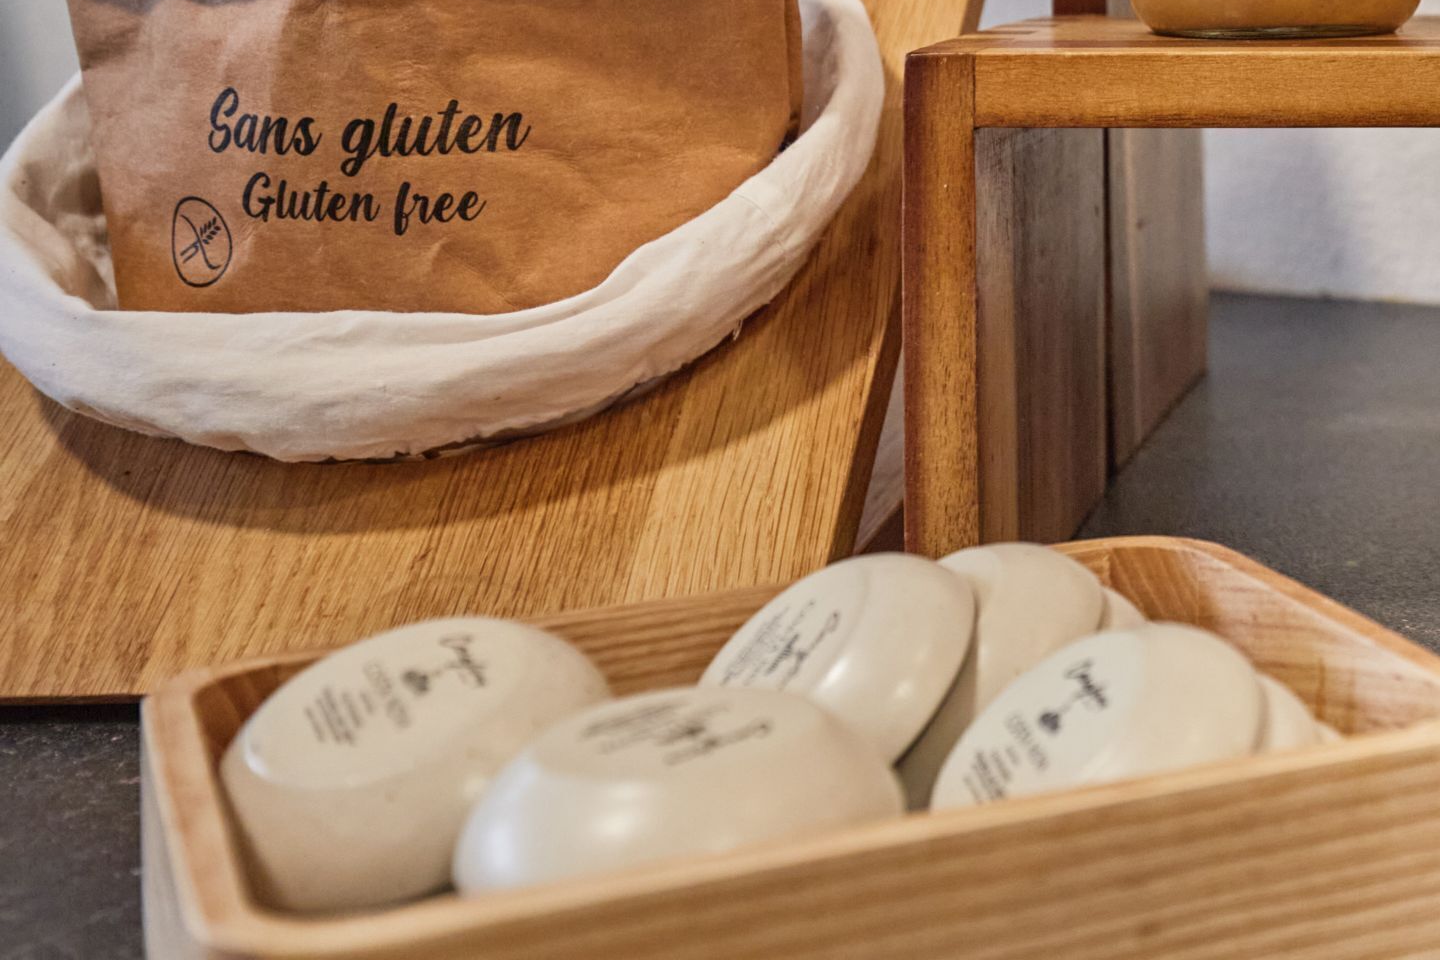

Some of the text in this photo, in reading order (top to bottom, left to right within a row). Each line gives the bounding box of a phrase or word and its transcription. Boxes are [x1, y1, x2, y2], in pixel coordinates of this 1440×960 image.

[208, 87, 532, 177] Sans gluten
[241, 171, 487, 237] Gluten free
